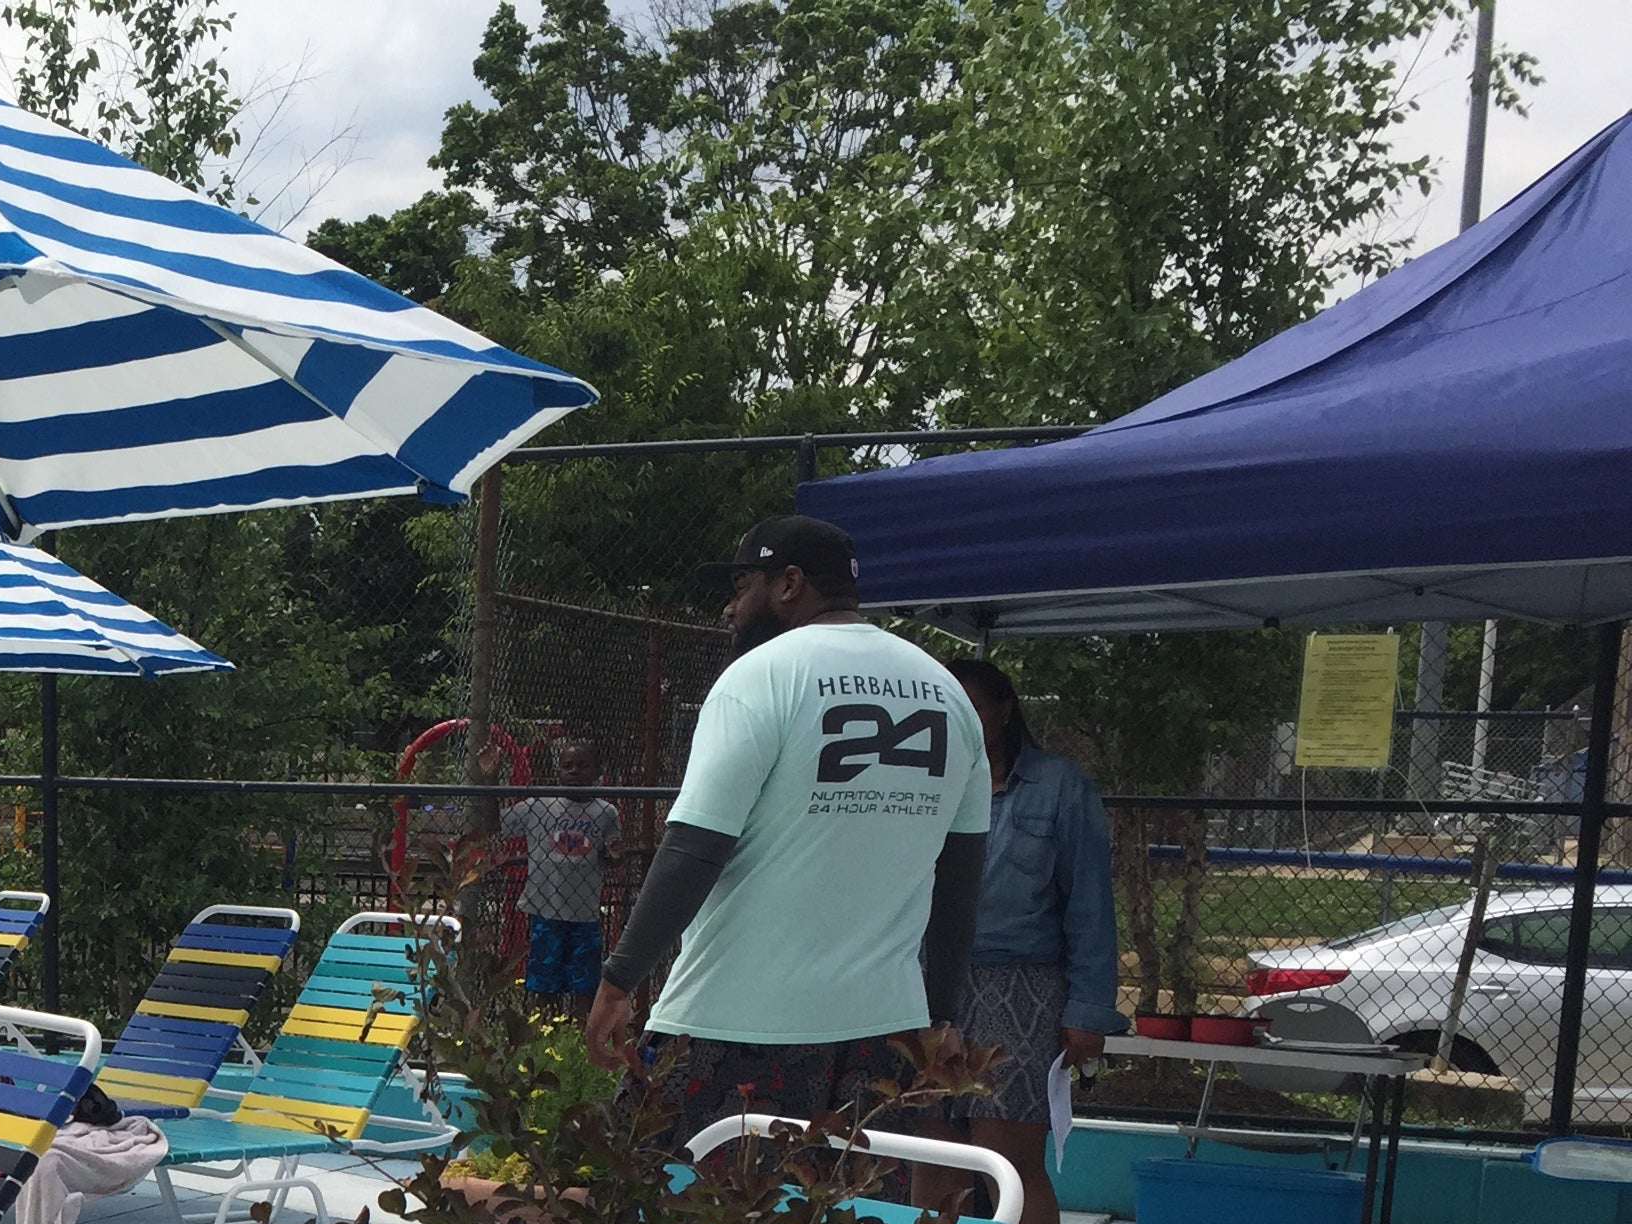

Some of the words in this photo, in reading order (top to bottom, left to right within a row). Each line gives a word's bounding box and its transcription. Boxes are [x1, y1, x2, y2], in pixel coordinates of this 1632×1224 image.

[818, 675, 945, 704] HERBALIFE
[817, 703, 948, 783] 24
[811, 790, 885, 801] NUTRITION
[889, 792, 914, 802] FOR
[919, 793, 941, 803] THE
[808, 804, 877, 815] 24-HOUR
[883, 804, 938, 815] ATHLETE
